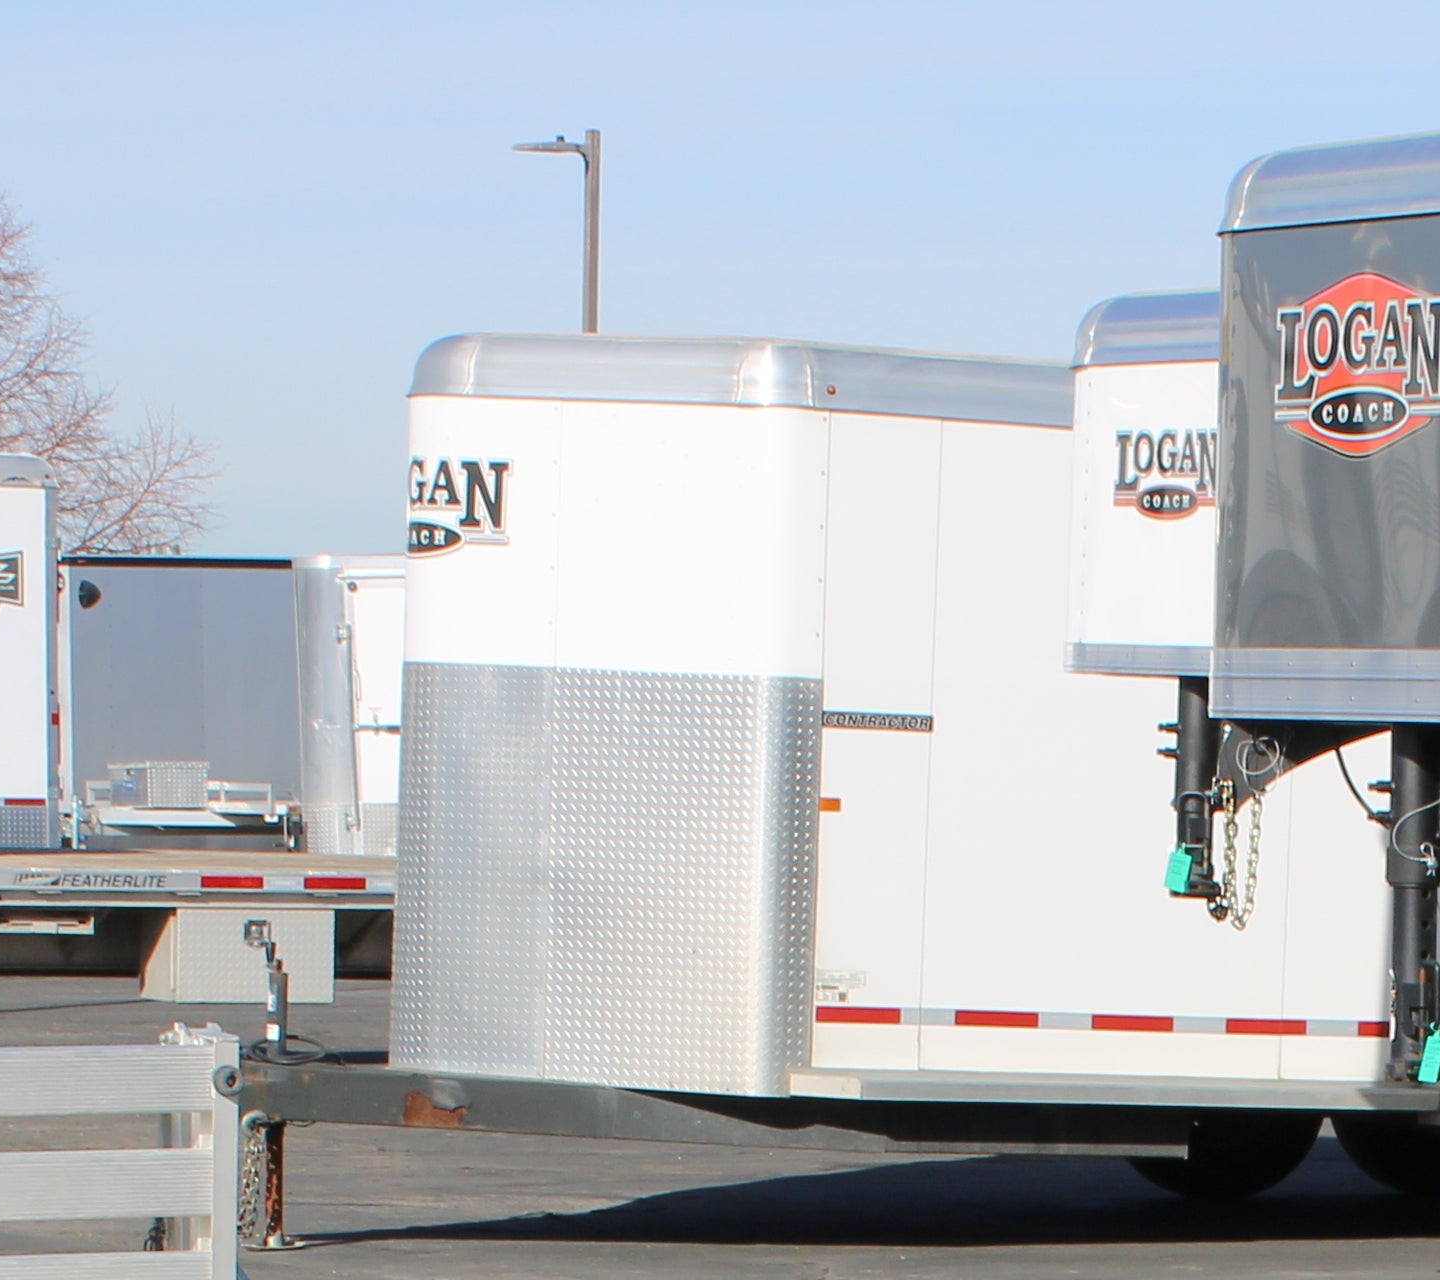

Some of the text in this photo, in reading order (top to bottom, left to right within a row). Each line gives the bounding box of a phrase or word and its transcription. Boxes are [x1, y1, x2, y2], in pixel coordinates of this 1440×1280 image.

[1321, 401, 1394, 425] COACH
[1113, 430, 1217, 494] LOGAN
[408, 456, 511, 532] GAN
[1142, 494, 1191, 509] COACH
[409, 529, 447, 546] ACH
[823, 713, 931, 731] CONTRACTOR
[61, 873, 167, 888] FEATHERLITE
